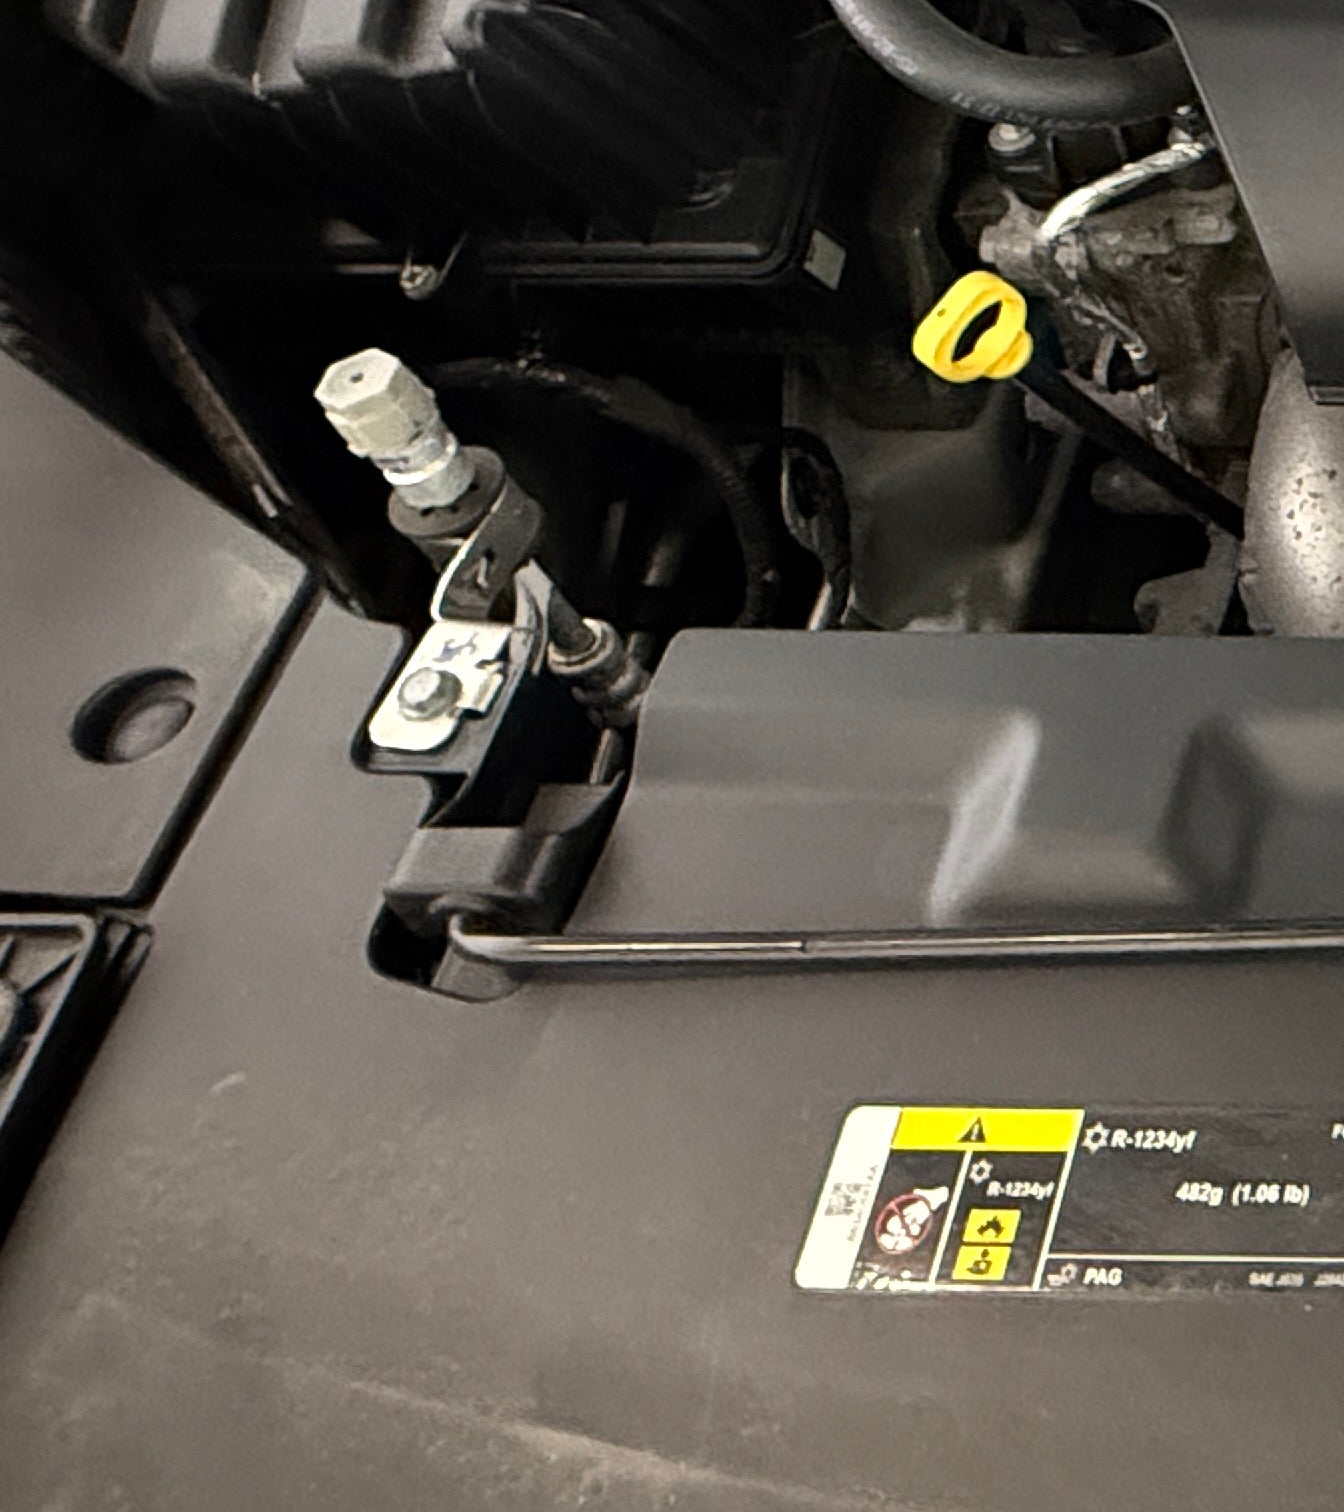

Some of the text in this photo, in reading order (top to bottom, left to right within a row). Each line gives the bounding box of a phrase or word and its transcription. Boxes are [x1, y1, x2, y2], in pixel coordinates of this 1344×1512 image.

[1110, 1129, 1197, 1153] R-1234yf
[1175, 1181, 1310, 1206] 482g (1.06 lb)
[1083, 1267, 1122, 1286] PAG
